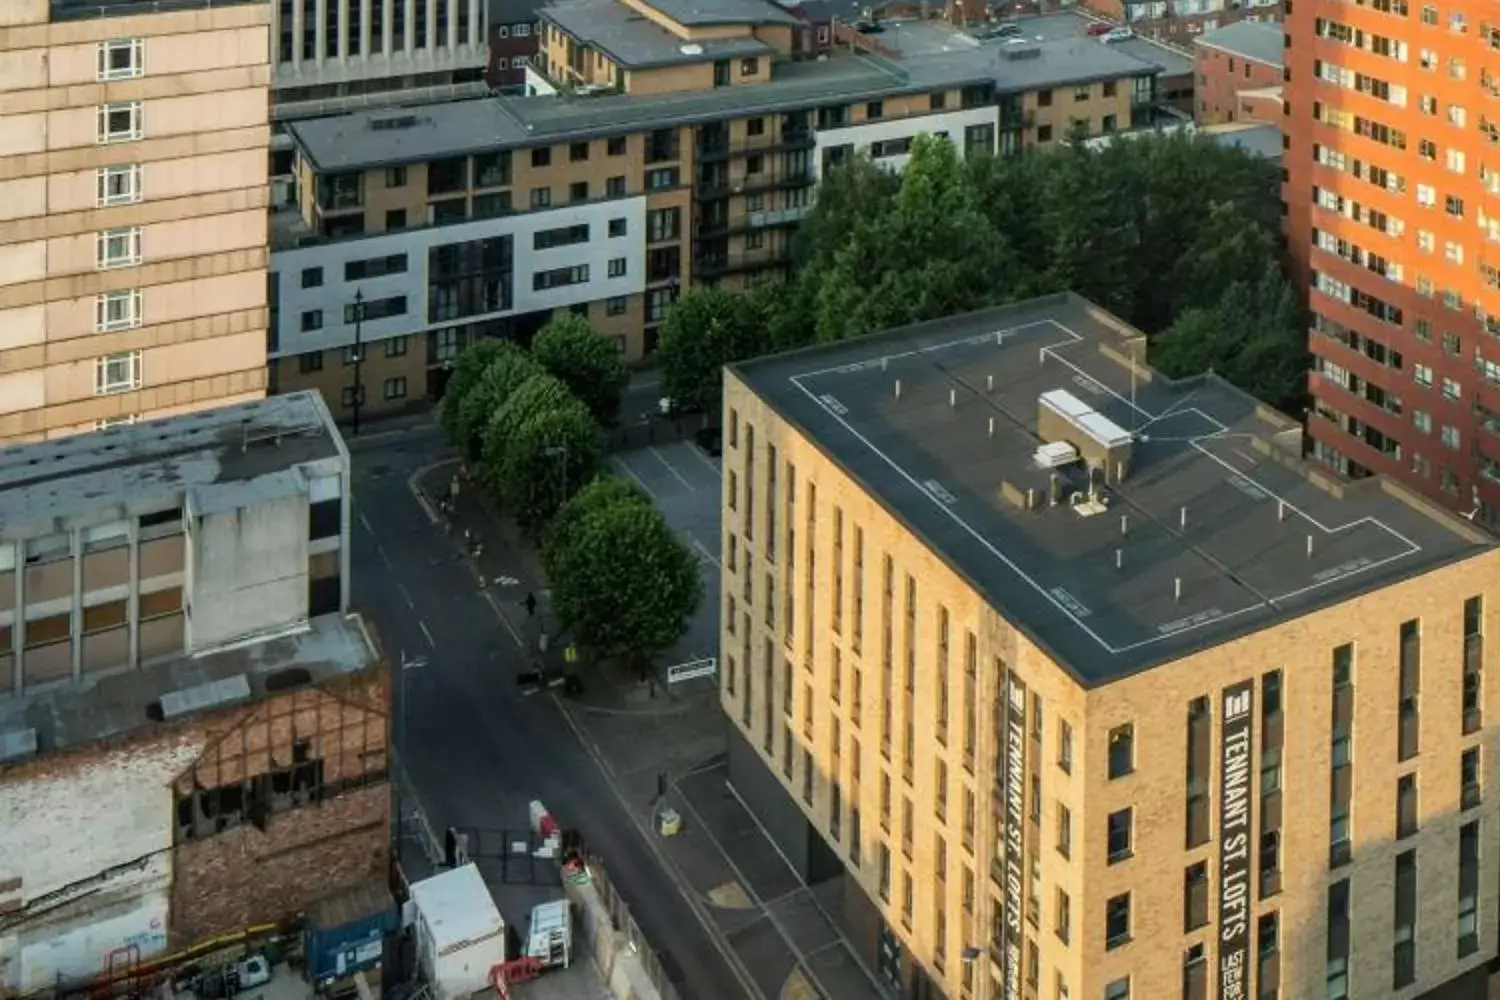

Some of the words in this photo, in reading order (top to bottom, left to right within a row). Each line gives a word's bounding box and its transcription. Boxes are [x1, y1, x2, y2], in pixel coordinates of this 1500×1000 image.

[1009, 720, 1023, 826] TENNANT
[1224, 725, 1249, 829] TENNANT
[1223, 832, 1248, 871] ST.
[1007, 860, 1022, 934] LOFTS
[1222, 868, 1247, 941] LOFTS
